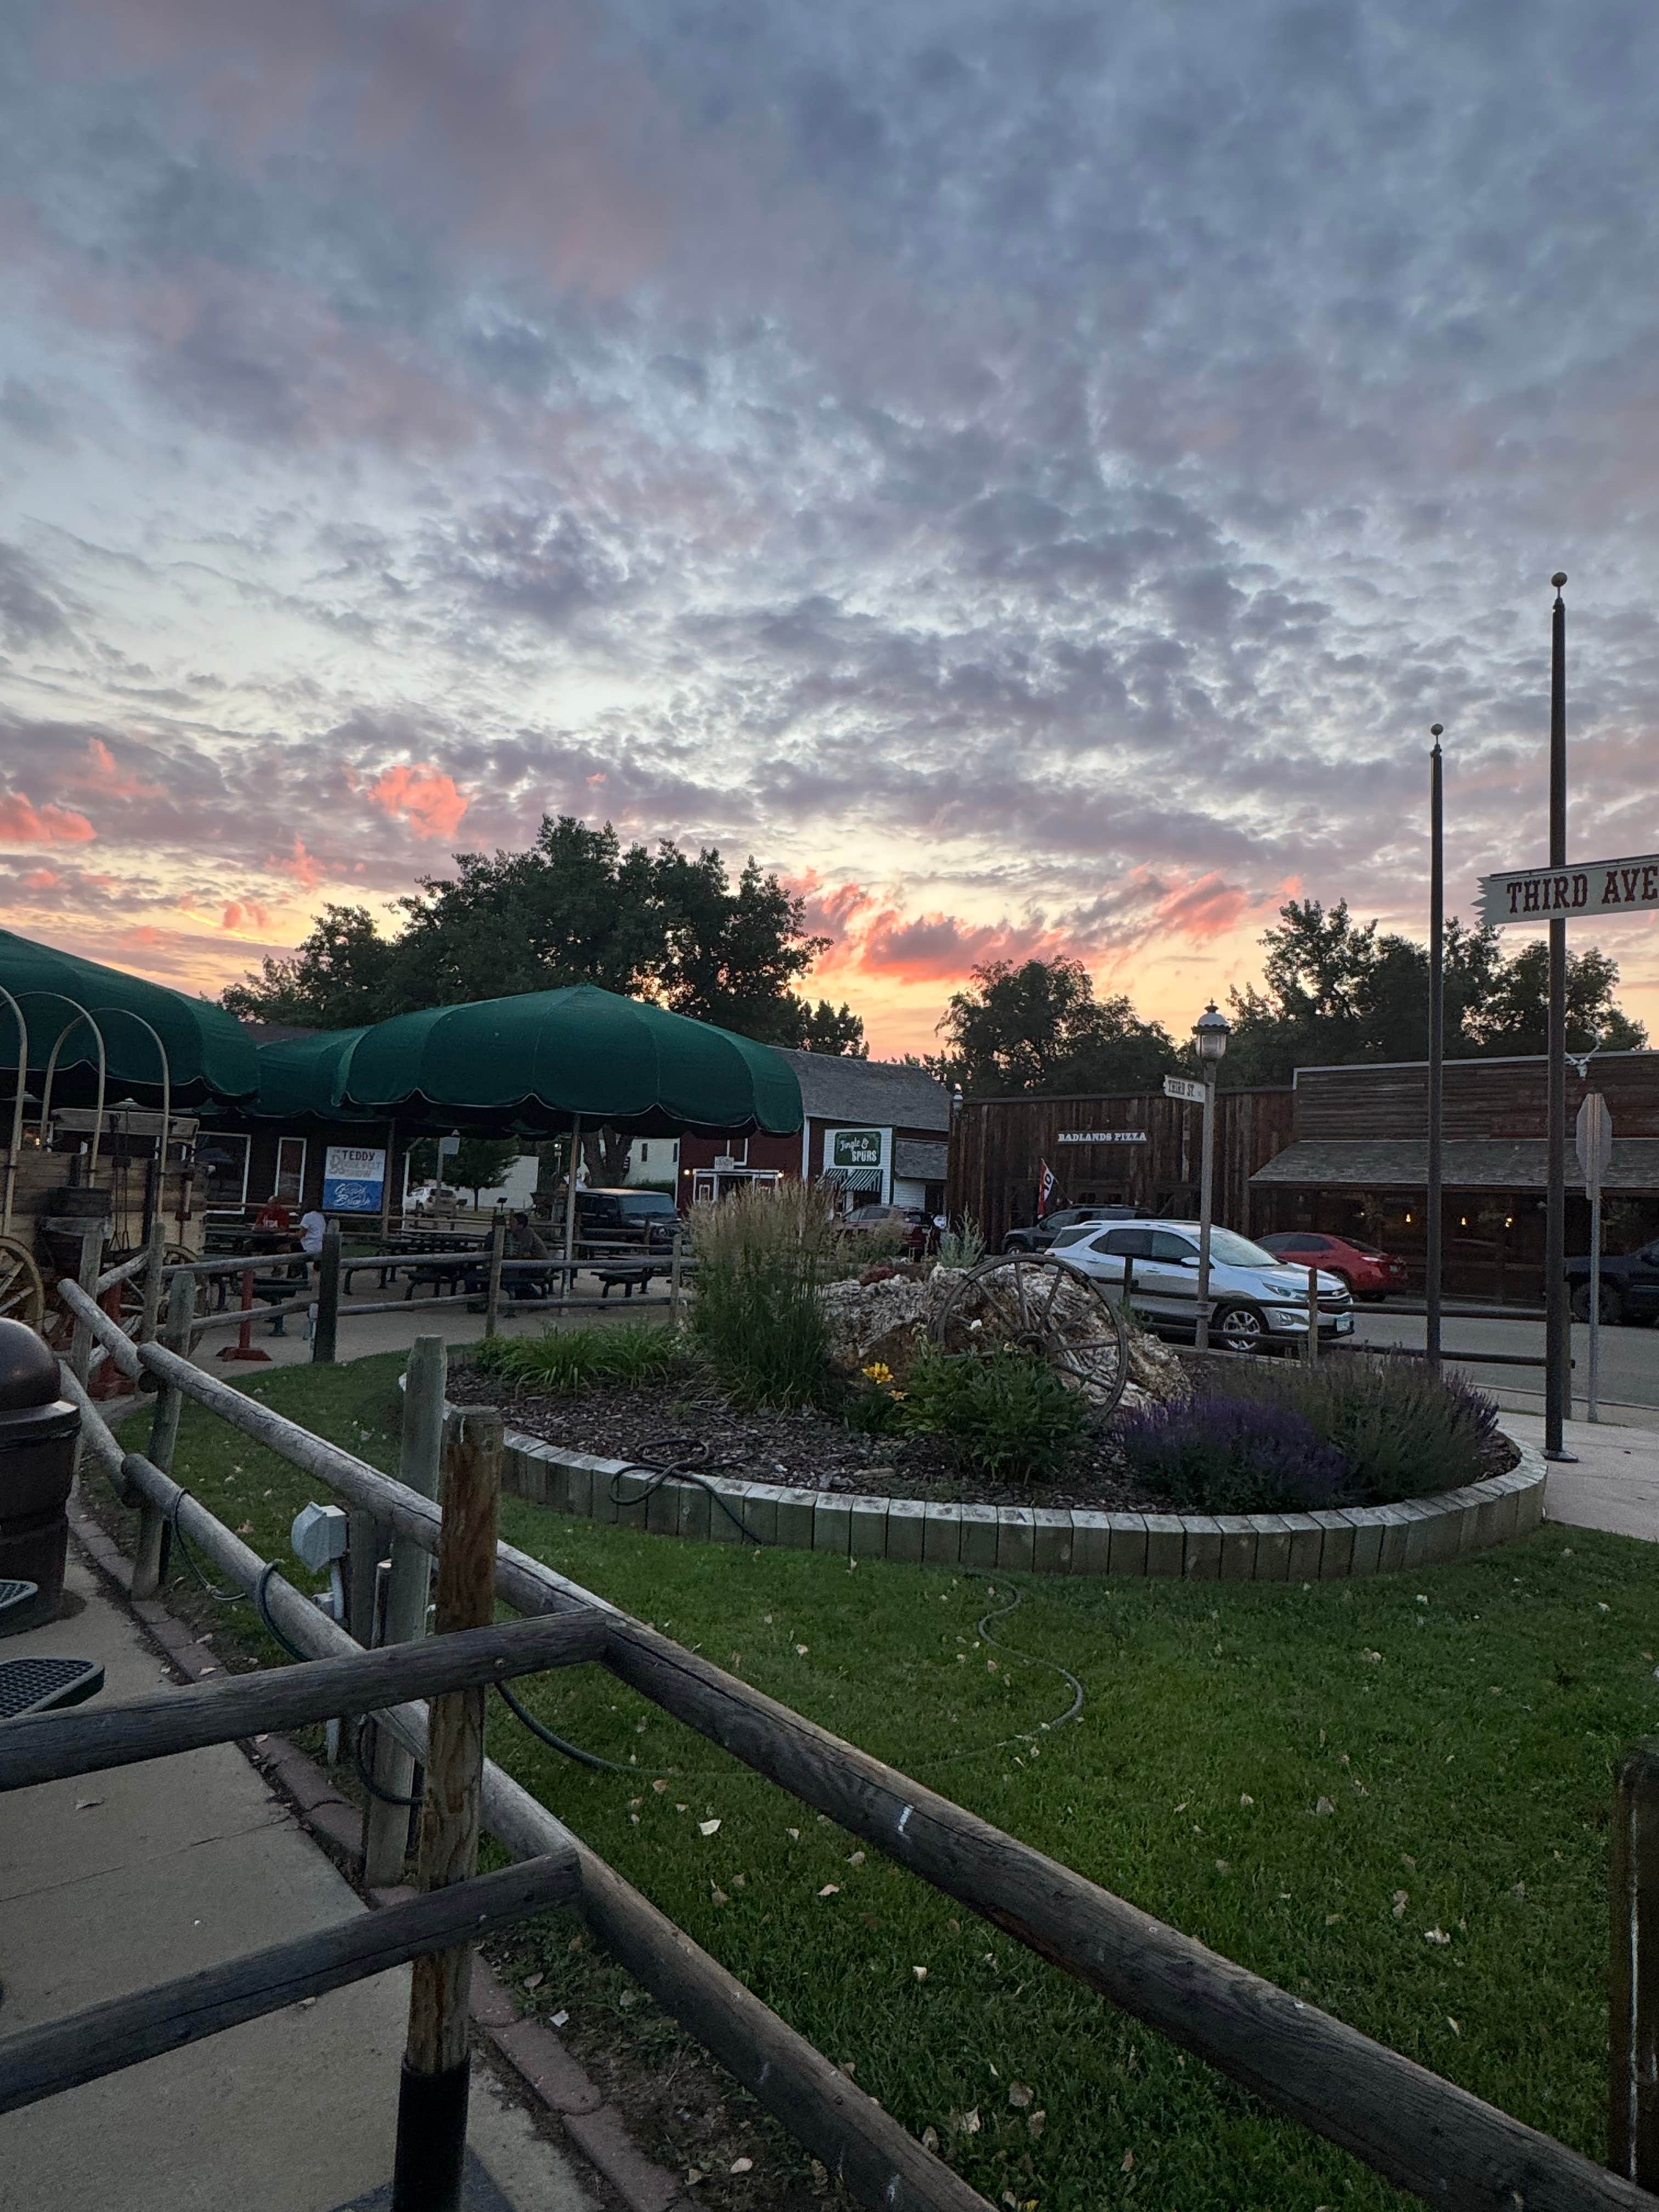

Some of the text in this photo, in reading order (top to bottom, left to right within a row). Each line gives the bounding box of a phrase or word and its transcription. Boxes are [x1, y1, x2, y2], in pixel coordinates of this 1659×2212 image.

[1506, 866, 1658, 913] THIRD AVE
[1058, 1132, 1147, 1142] BADLANDS PIZZA
[341, 1150, 375, 1161] TEDDY
[851, 1150, 877, 1162] SPURS
